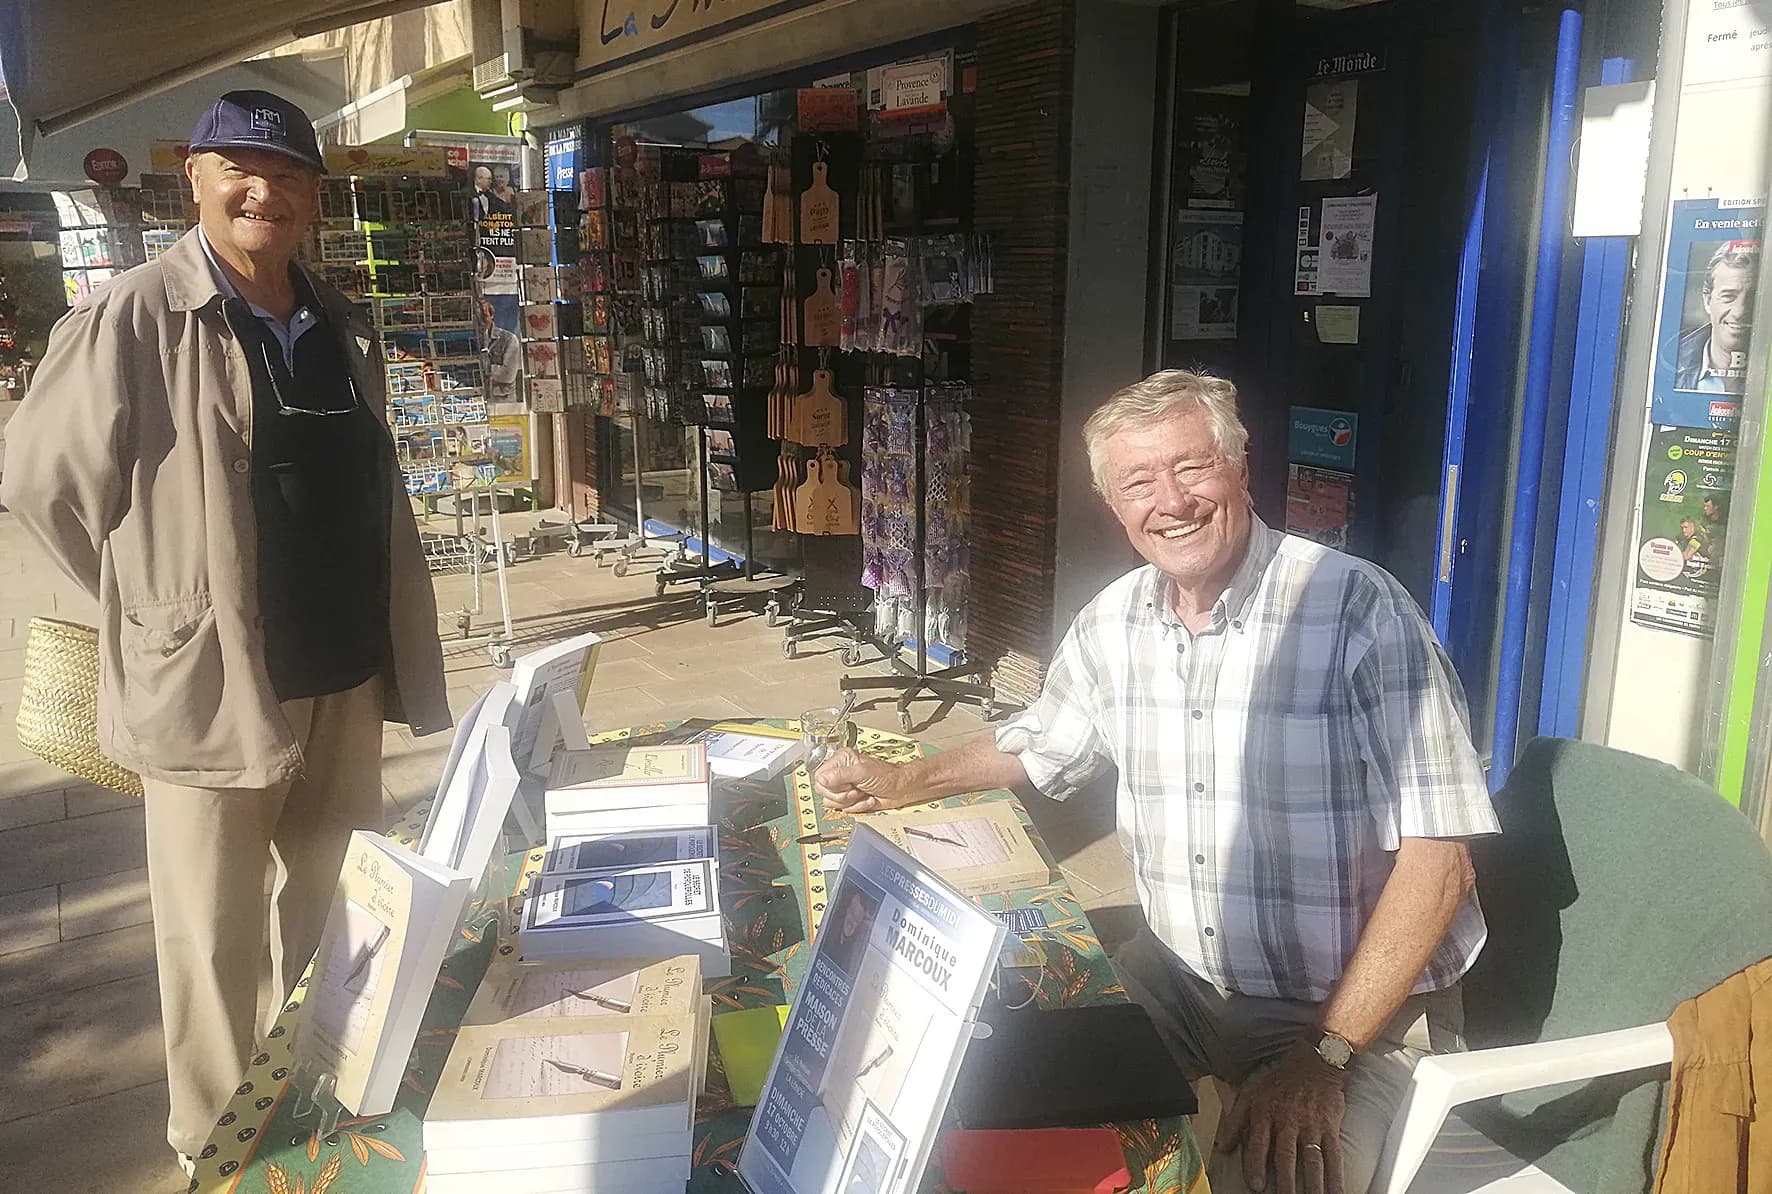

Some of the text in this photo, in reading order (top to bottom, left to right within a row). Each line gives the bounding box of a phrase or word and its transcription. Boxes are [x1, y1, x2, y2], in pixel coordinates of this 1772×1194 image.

[1707, 29, 1738, 43] Fermé
[1315, 52, 1377, 76] Le Monde
[895, 78, 929, 92] Provence
[896, 93, 929, 107] Lavande
[557, 124, 582, 139] MAISON
[557, 166, 574, 179] Presse
[1695, 219, 1710, 229] En
[1712, 219, 1740, 229] vente
[1683, 449, 1705, 457] COUP
[1706, 450, 1729, 459] D'ENV
[892, 908, 957, 967] Dominique
[886, 926, 952, 992] MARCOUX
[815, 959, 851, 996] RENCONTRES
[804, 990, 839, 1031] MAISON
[806, 1010, 827, 1039] DE LA
[796, 1017, 829, 1058] PRESSE
[654, 1028, 682, 1080] Le Plumier
[770, 1086, 806, 1132] DIMANCHE
[766, 1102, 777, 1118] 17
[774, 1111, 799, 1146] OCTOBRE
